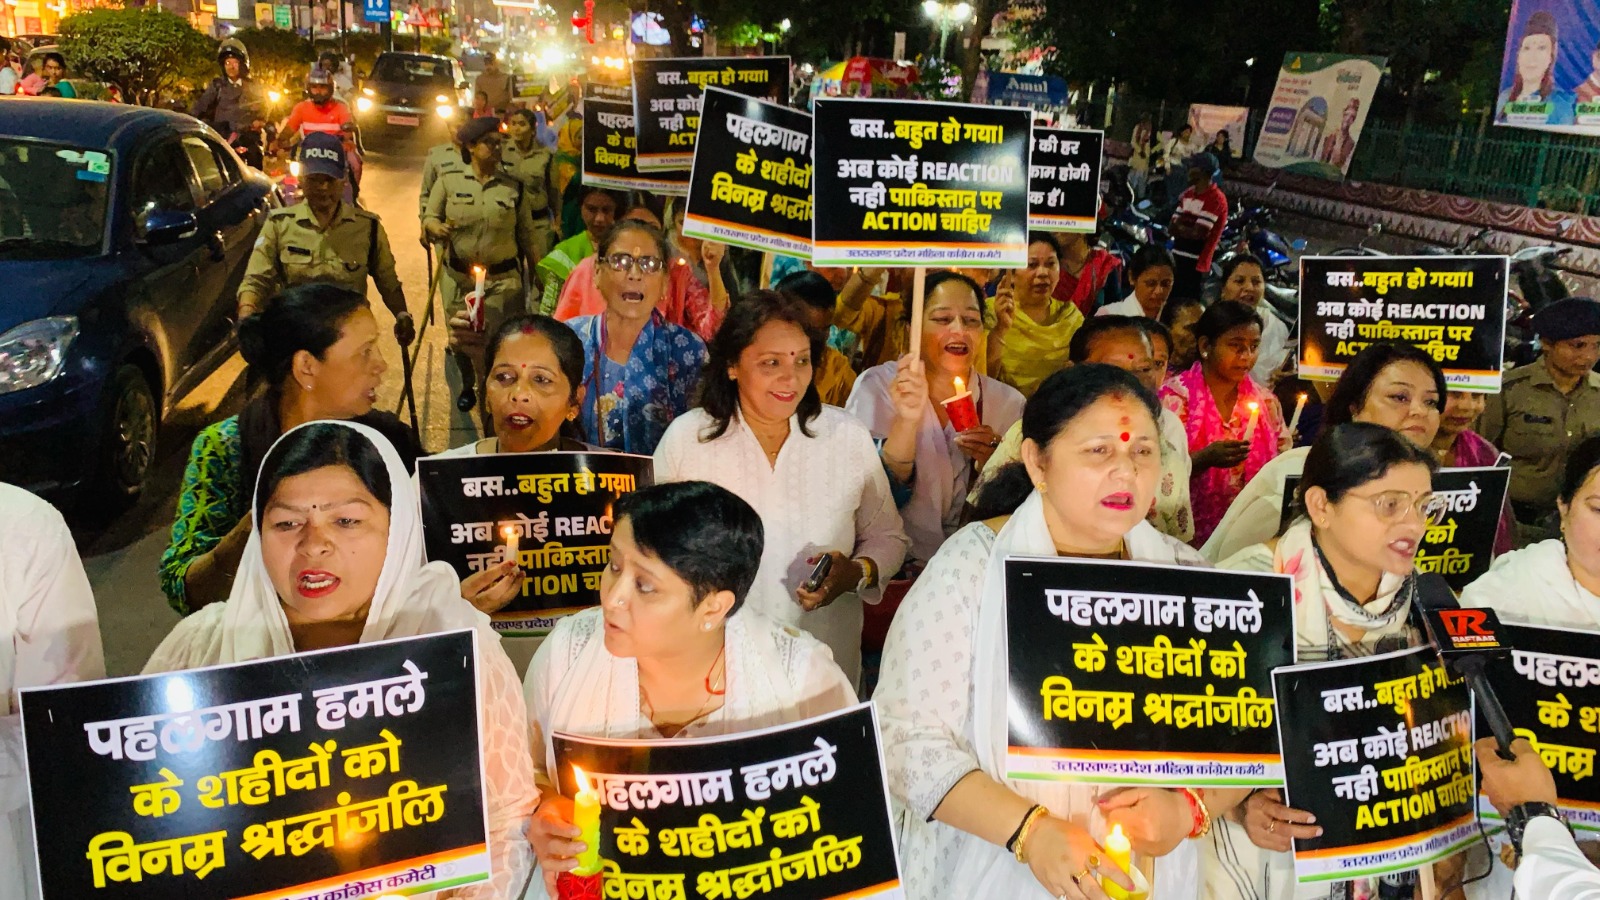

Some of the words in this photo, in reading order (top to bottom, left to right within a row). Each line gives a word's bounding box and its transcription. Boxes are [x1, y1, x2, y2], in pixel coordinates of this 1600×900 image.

[721, 67, 735, 85] हो
[1006, 77, 1048, 92] Amul
[650, 98, 676, 112] अब
[607, 131, 622, 147] के
[669, 133, 697, 145] ACT
[726, 113, 809, 155] पहलगाम
[941, 117, 961, 144] हो
[964, 124, 1003, 144] गया।
[305, 147, 339, 162] POLICE
[1039, 135, 1058, 154] की
[1061, 140, 1081, 155] हर
[736, 148, 759, 175] के
[837, 159, 874, 179] अब
[877, 154, 918, 184] कोई
[922, 162, 1013, 184] REACTION
[1059, 162, 1091, 182] होगी
[711, 171, 768, 214] विनम्र
[849, 182, 886, 209] नही
[889, 182, 977, 209] पाकिस्तान
[980, 191, 1003, 210] पर
[862, 212, 936, 231] ACTION
[940, 208, 992, 235] चाहिए
[1406, 267, 1427, 290] हो
[1317, 301, 1346, 317] अब
[1348, 298, 1384, 321] कोई
[1387, 303, 1485, 320] REACTION
[1358, 320, 1445, 342] पाकिस्तान
[1447, 325, 1473, 342] पर
[1336, 341, 1368, 356] ACT
[572, 467, 596, 495] हो
[451, 521, 493, 544] अब
[555, 515, 612, 537] REAC
[1426, 518, 1458, 544] को
[521, 574, 578, 597] TION
[525, 617, 554, 629] प्रदेश
[1045, 589, 1186, 627] पहलगाम
[1192, 589, 1264, 633] हमले
[1072, 633, 1108, 673] के
[1116, 634, 1207, 679] शहीदों
[1209, 640, 1247, 679] को
[1418, 665, 1435, 699] हो
[84, 692, 302, 761] पहलगाम
[313, 659, 428, 731] हमले
[1041, 676, 1134, 730] विनम्र
[1143, 684, 1276, 729] श्रद्धांजलि
[1536, 693, 1572, 729] के
[1314, 739, 1358, 767] अब
[1362, 722, 1408, 760] कोई
[1411, 709, 1472, 750] REACTIO
[131, 768, 181, 818] के
[197, 740, 337, 808] शहीदों
[342, 729, 402, 779] को
[741, 737, 837, 800] हमले
[1120, 760, 1151, 775] प्रदेश
[1155, 760, 1194, 775] महिला
[1196, 761, 1233, 776] कांग्रेस
[1235, 763, 1265, 776] कमेटी
[1381, 747, 1461, 792] पाकिस्तान
[1355, 789, 1436, 830] ACTION
[86, 831, 227, 888] विनम्र
[240, 780, 448, 860] श्रद्धांजलि
[614, 816, 649, 856] के
[658, 806, 766, 858] शहीदों
[770, 795, 821, 840] को
[696, 835, 863, 900] श्रद्धांजलि
[324, 879, 384, 900] कांग्रेस
[386, 865, 437, 887] कमेटी
